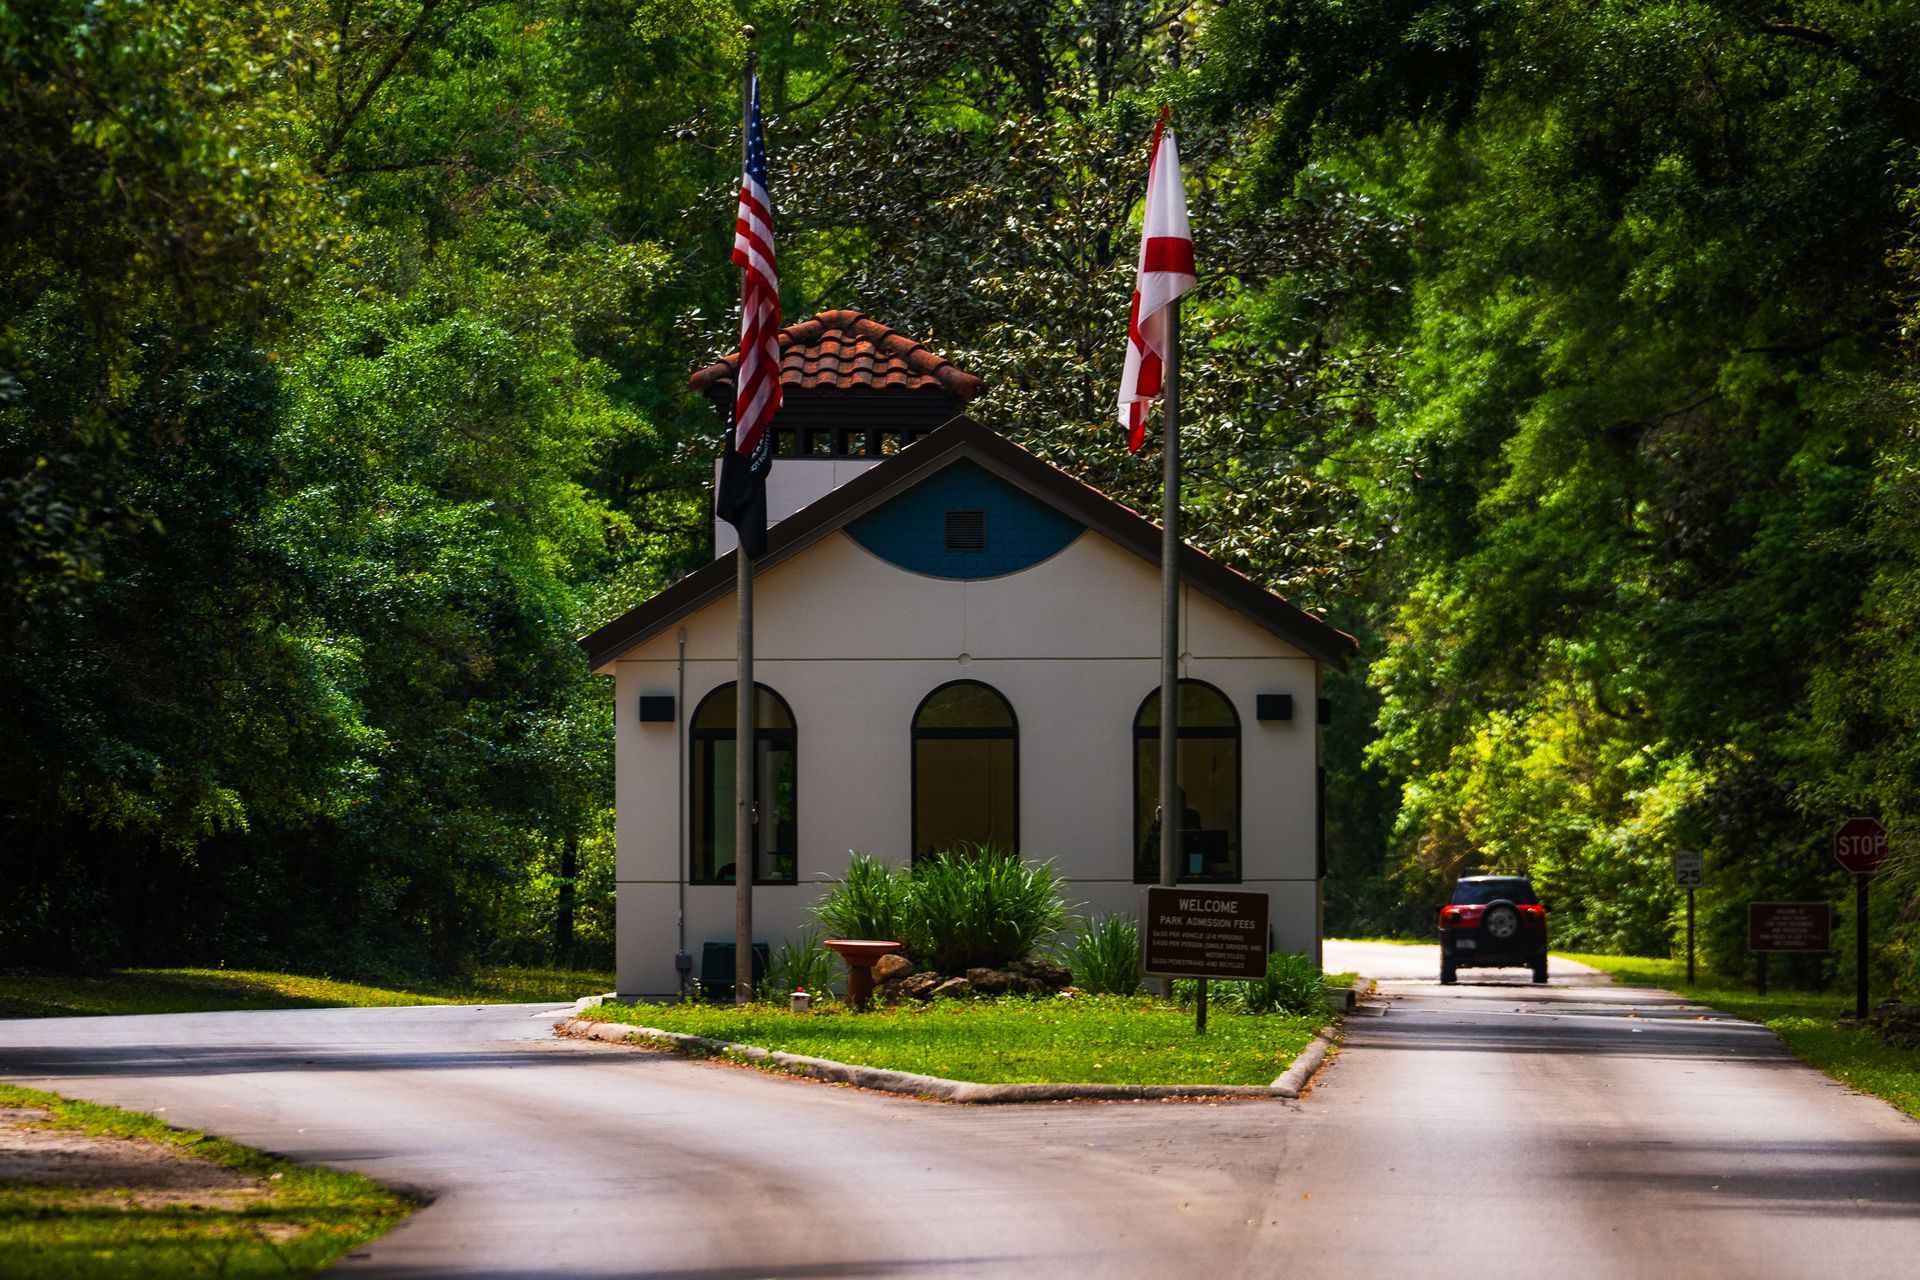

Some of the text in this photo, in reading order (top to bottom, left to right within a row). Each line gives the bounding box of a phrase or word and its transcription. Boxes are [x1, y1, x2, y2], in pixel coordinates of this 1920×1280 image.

[1839, 835, 1886, 855] STOP
[1677, 869, 1701, 884] 25
[1179, 898, 1239, 913] WELCOME
[1160, 915, 1255, 929] PARK ADMISSION FEES
[1182, 931, 1204, 939] VEHICLE
[1181, 940, 1203, 948] PERSON
[1225, 943, 1248, 951] DRIVERS
[1168, 958, 1205, 966] PEDESTRIANS
